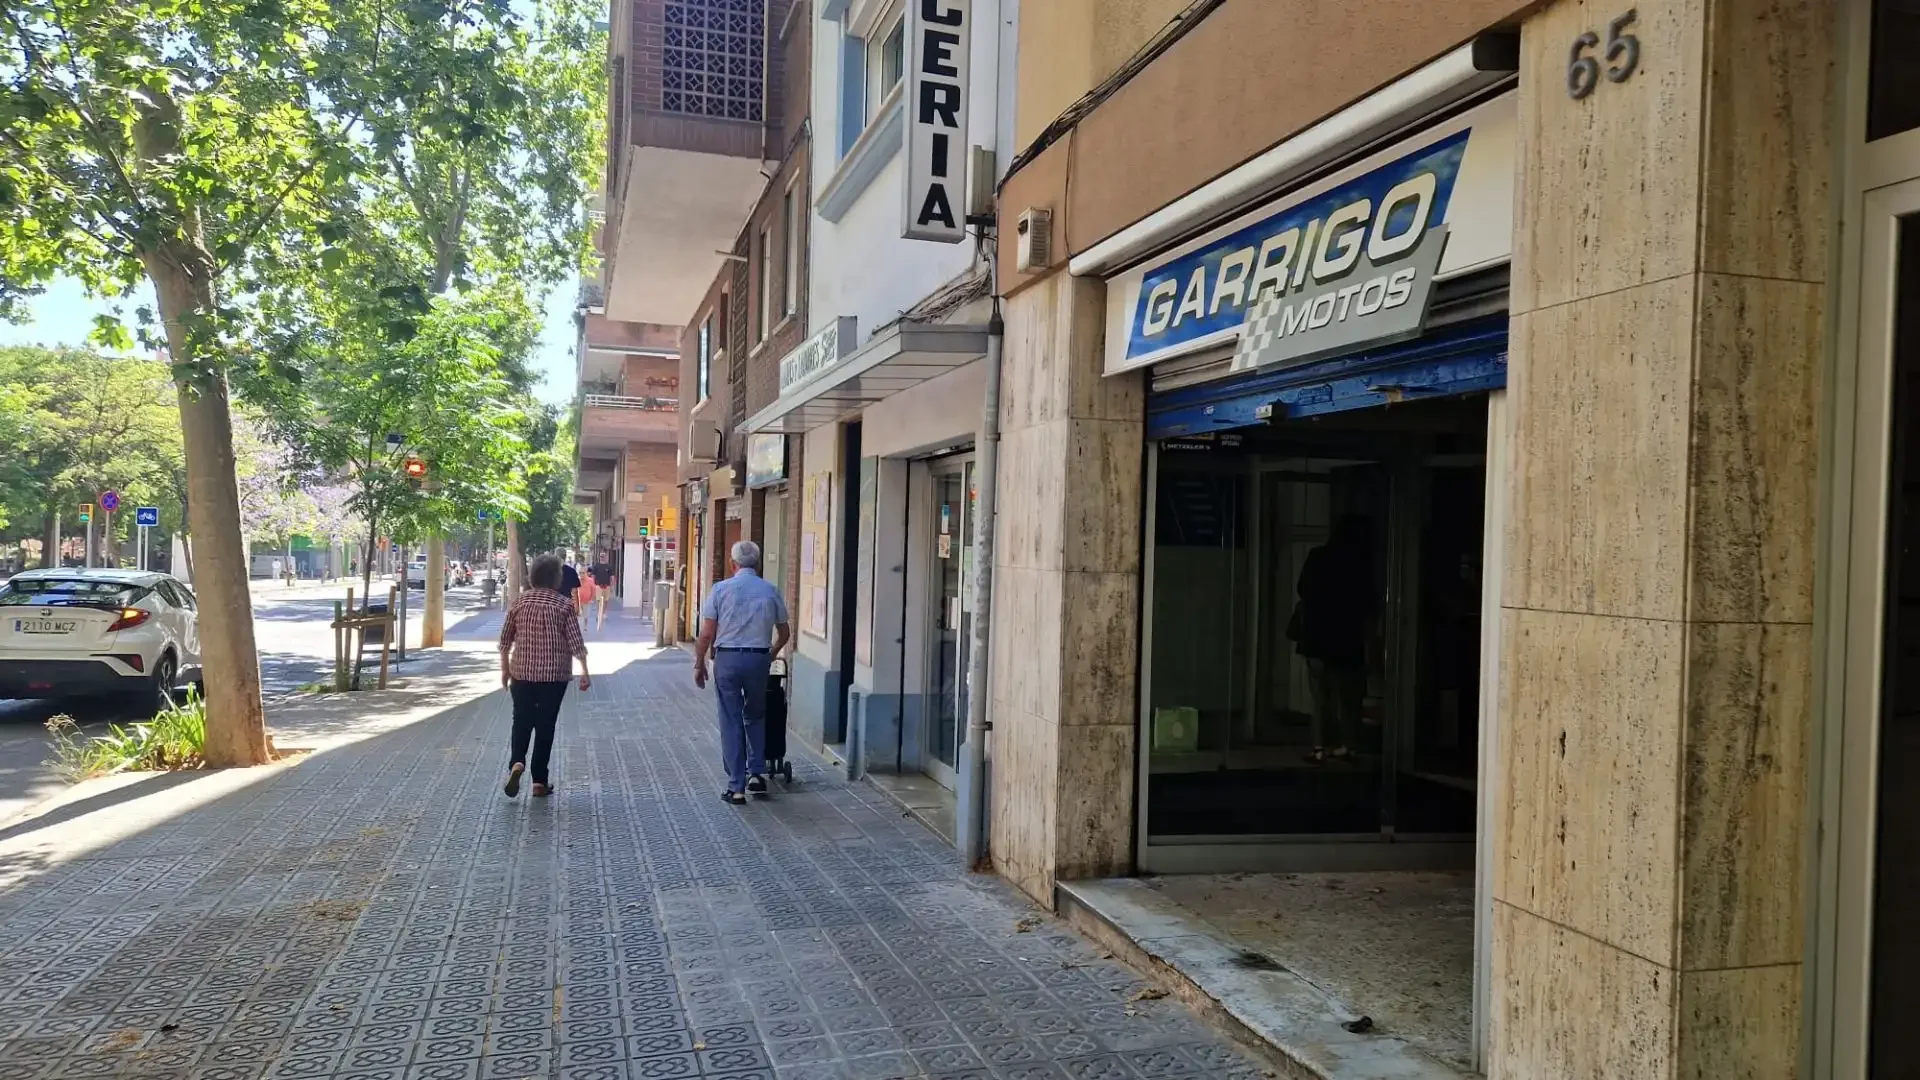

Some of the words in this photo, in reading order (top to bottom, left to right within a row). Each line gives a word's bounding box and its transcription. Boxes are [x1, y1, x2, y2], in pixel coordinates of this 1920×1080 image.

[1567, 8, 1640, 100] 65
[1142, 171, 1437, 337] GARRIGO
[1277, 266, 1417, 339] MOTOS
[23, 621, 52, 631] 2110
[55, 622, 76, 631] MCZ
